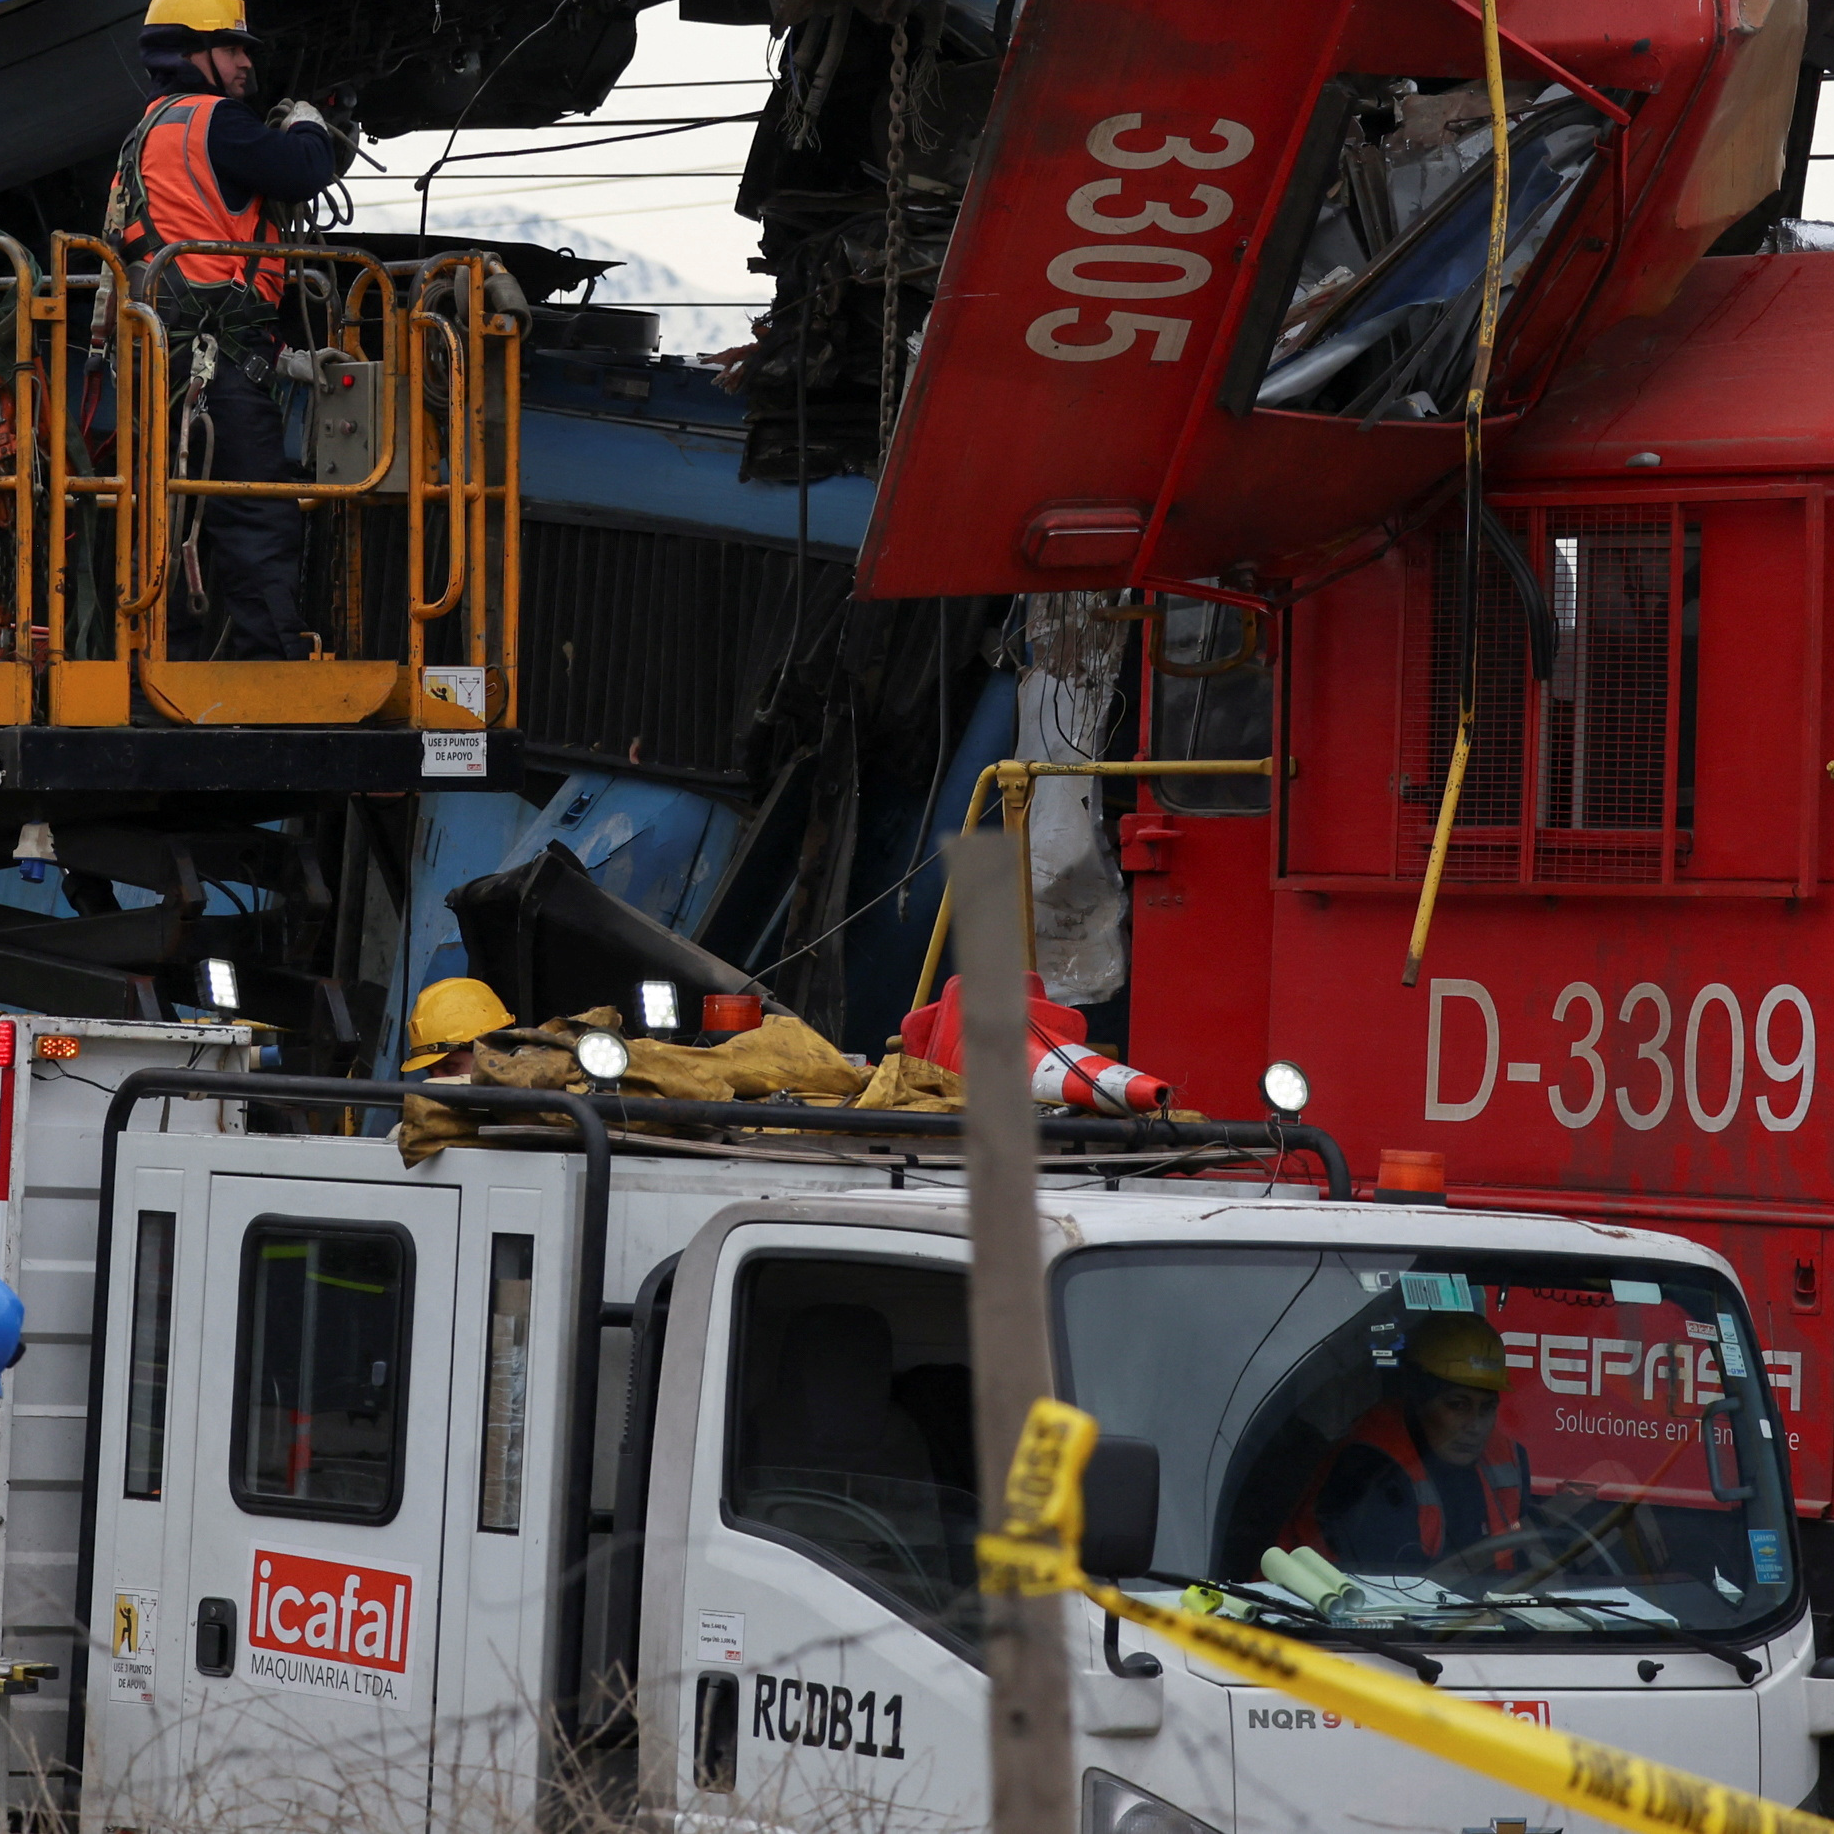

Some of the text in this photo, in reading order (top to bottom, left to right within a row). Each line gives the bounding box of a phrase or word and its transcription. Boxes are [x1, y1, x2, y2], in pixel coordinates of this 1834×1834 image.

[1024, 112, 1255, 363] 3305
[428, 738, 480, 747] USE 3 PUNTOS
[435, 752, 473, 761] DE APOYO
[1424, 978, 1817, 1133] D-3309
[1554, 1407, 1658, 1440] Soluciones
[1665, 1420, 1688, 1442] en
[256, 1559, 406, 1662] icafal
[701, 1635, 711, 1643] Carga
[251, 1653, 398, 1700] MAQUINARIA LTDA.
[753, 1674, 905, 1760] RCDB11
[1249, 1709, 1316, 1730] NQR
